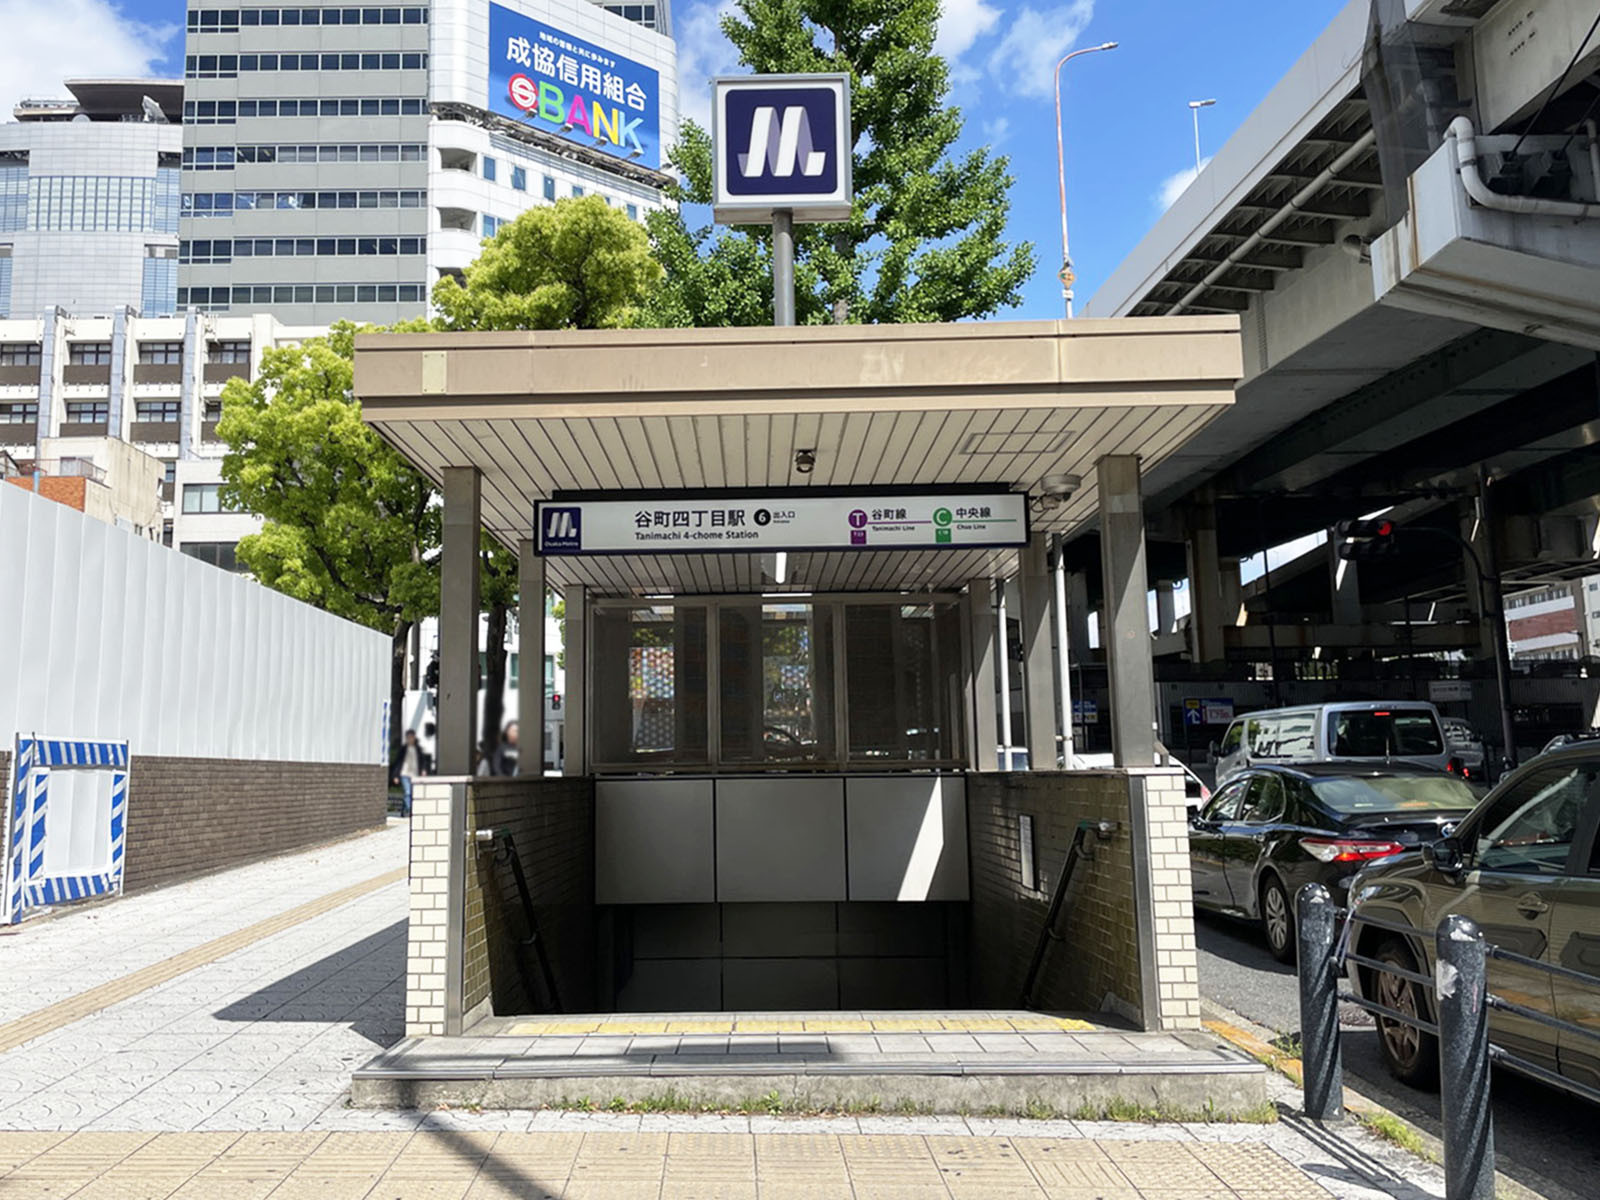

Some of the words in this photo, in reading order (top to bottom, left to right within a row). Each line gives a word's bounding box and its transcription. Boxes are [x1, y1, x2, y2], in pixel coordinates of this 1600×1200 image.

[507, 37, 646, 111] 成協信用組合
[635, 510, 746, 527] 谷町四丁目駅
[872, 509, 907, 520] 谷町線
[956, 508, 991, 518] 中央線
[635, 532, 681, 541] Tanimachi
[683, 531, 725, 540] 4-chome
[726, 530, 759, 540] Station
